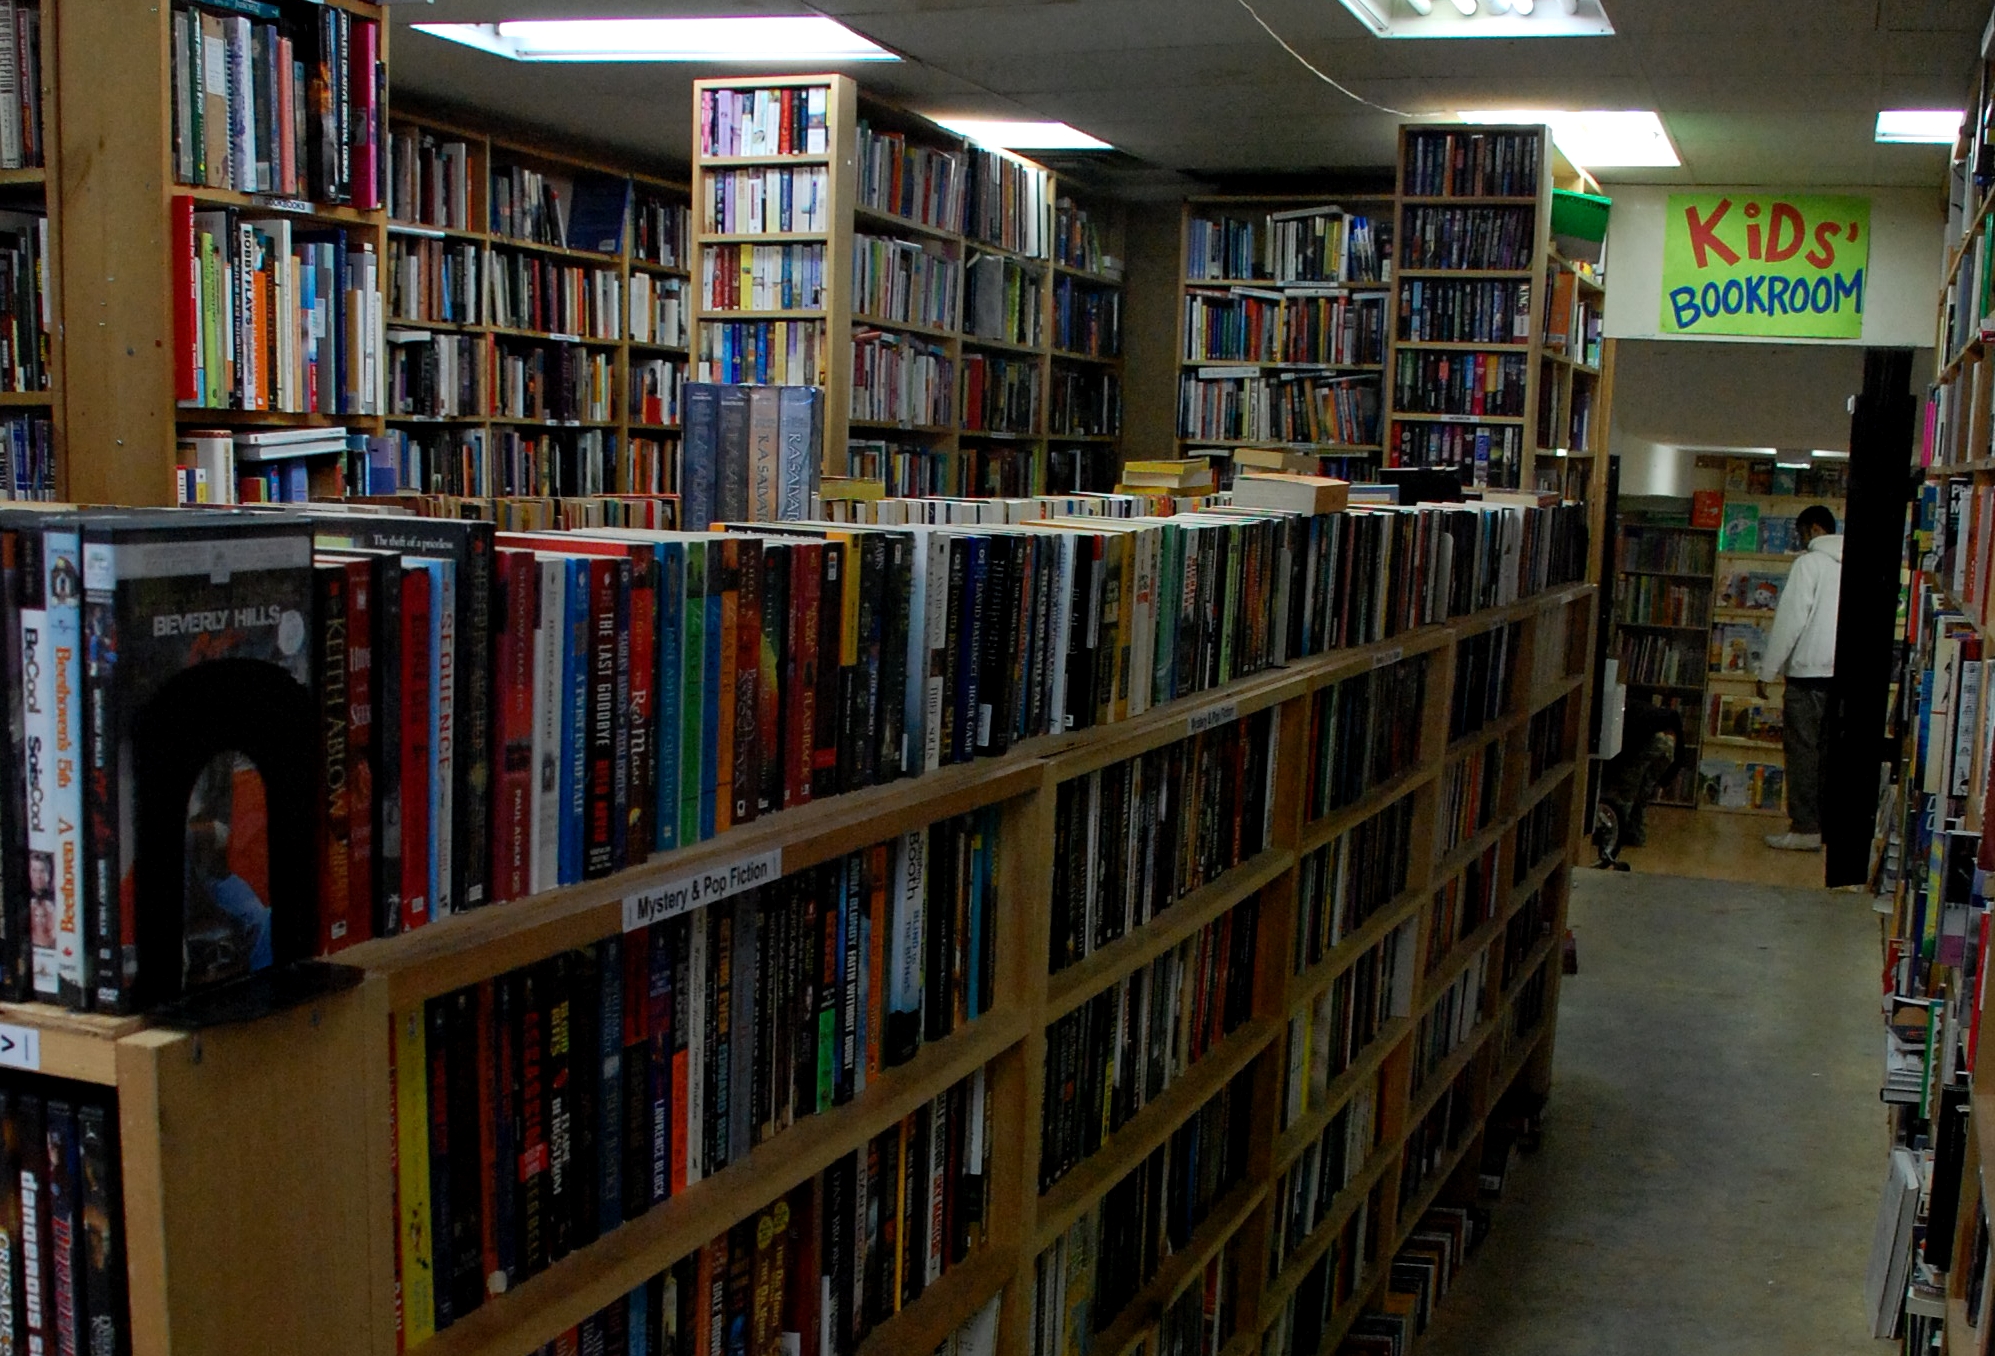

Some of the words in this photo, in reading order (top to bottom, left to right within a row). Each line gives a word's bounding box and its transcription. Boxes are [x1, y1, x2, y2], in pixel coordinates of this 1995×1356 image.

[243, 230, 252, 277] BOBBY
[1669, 268, 1864, 329] BOOKROOM
[373, 534, 388, 548] The
[389, 535, 405, 548] theft
[875, 540, 885, 570] JAWS
[153, 609, 229, 637] BEVERLY
[234, 604, 281, 627] HILLS
[516, 566, 526, 638] SHADOW
[974, 582, 984, 618] DAVID
[599, 611, 614, 637] THE
[326, 616, 347, 705] KEITH
[597, 644, 613, 675] LAST
[970, 621, 981, 677] BALDACCI
[439, 612, 453, 770] SEQUENCE
[575, 685, 586, 728] TWIST
[629, 689, 647, 725] Red
[966, 685, 976, 718] HOUR
[595, 682, 612, 747] GOODBYE
[801, 691, 813, 778] FLASHBACK
[964, 721, 973, 753] GAME
[327, 717, 346, 818] ABLOW
[630, 728, 646, 786] Mass
[513, 788, 522, 822] PAUL
[513, 826, 522, 867] ADAM
[906, 832, 920, 900] Booth
[915, 840, 924, 885] Stephen
[60, 841, 76, 933] Beethoven
[637, 888, 688, 921] Mystery
[692, 880, 700, 900] &
[704, 876, 726, 902] Pop
[730, 861, 768, 887] Fiction
[846, 949, 858, 981] FAITH
[844, 983, 856, 1032] WITHOUT
[843, 1034, 854, 1070] DOUBT
[551, 1096, 563, 1196] BERGSTROM
[654, 1098, 665, 1157] LAWRENCE
[653, 1160, 665, 1199] BLOCK
